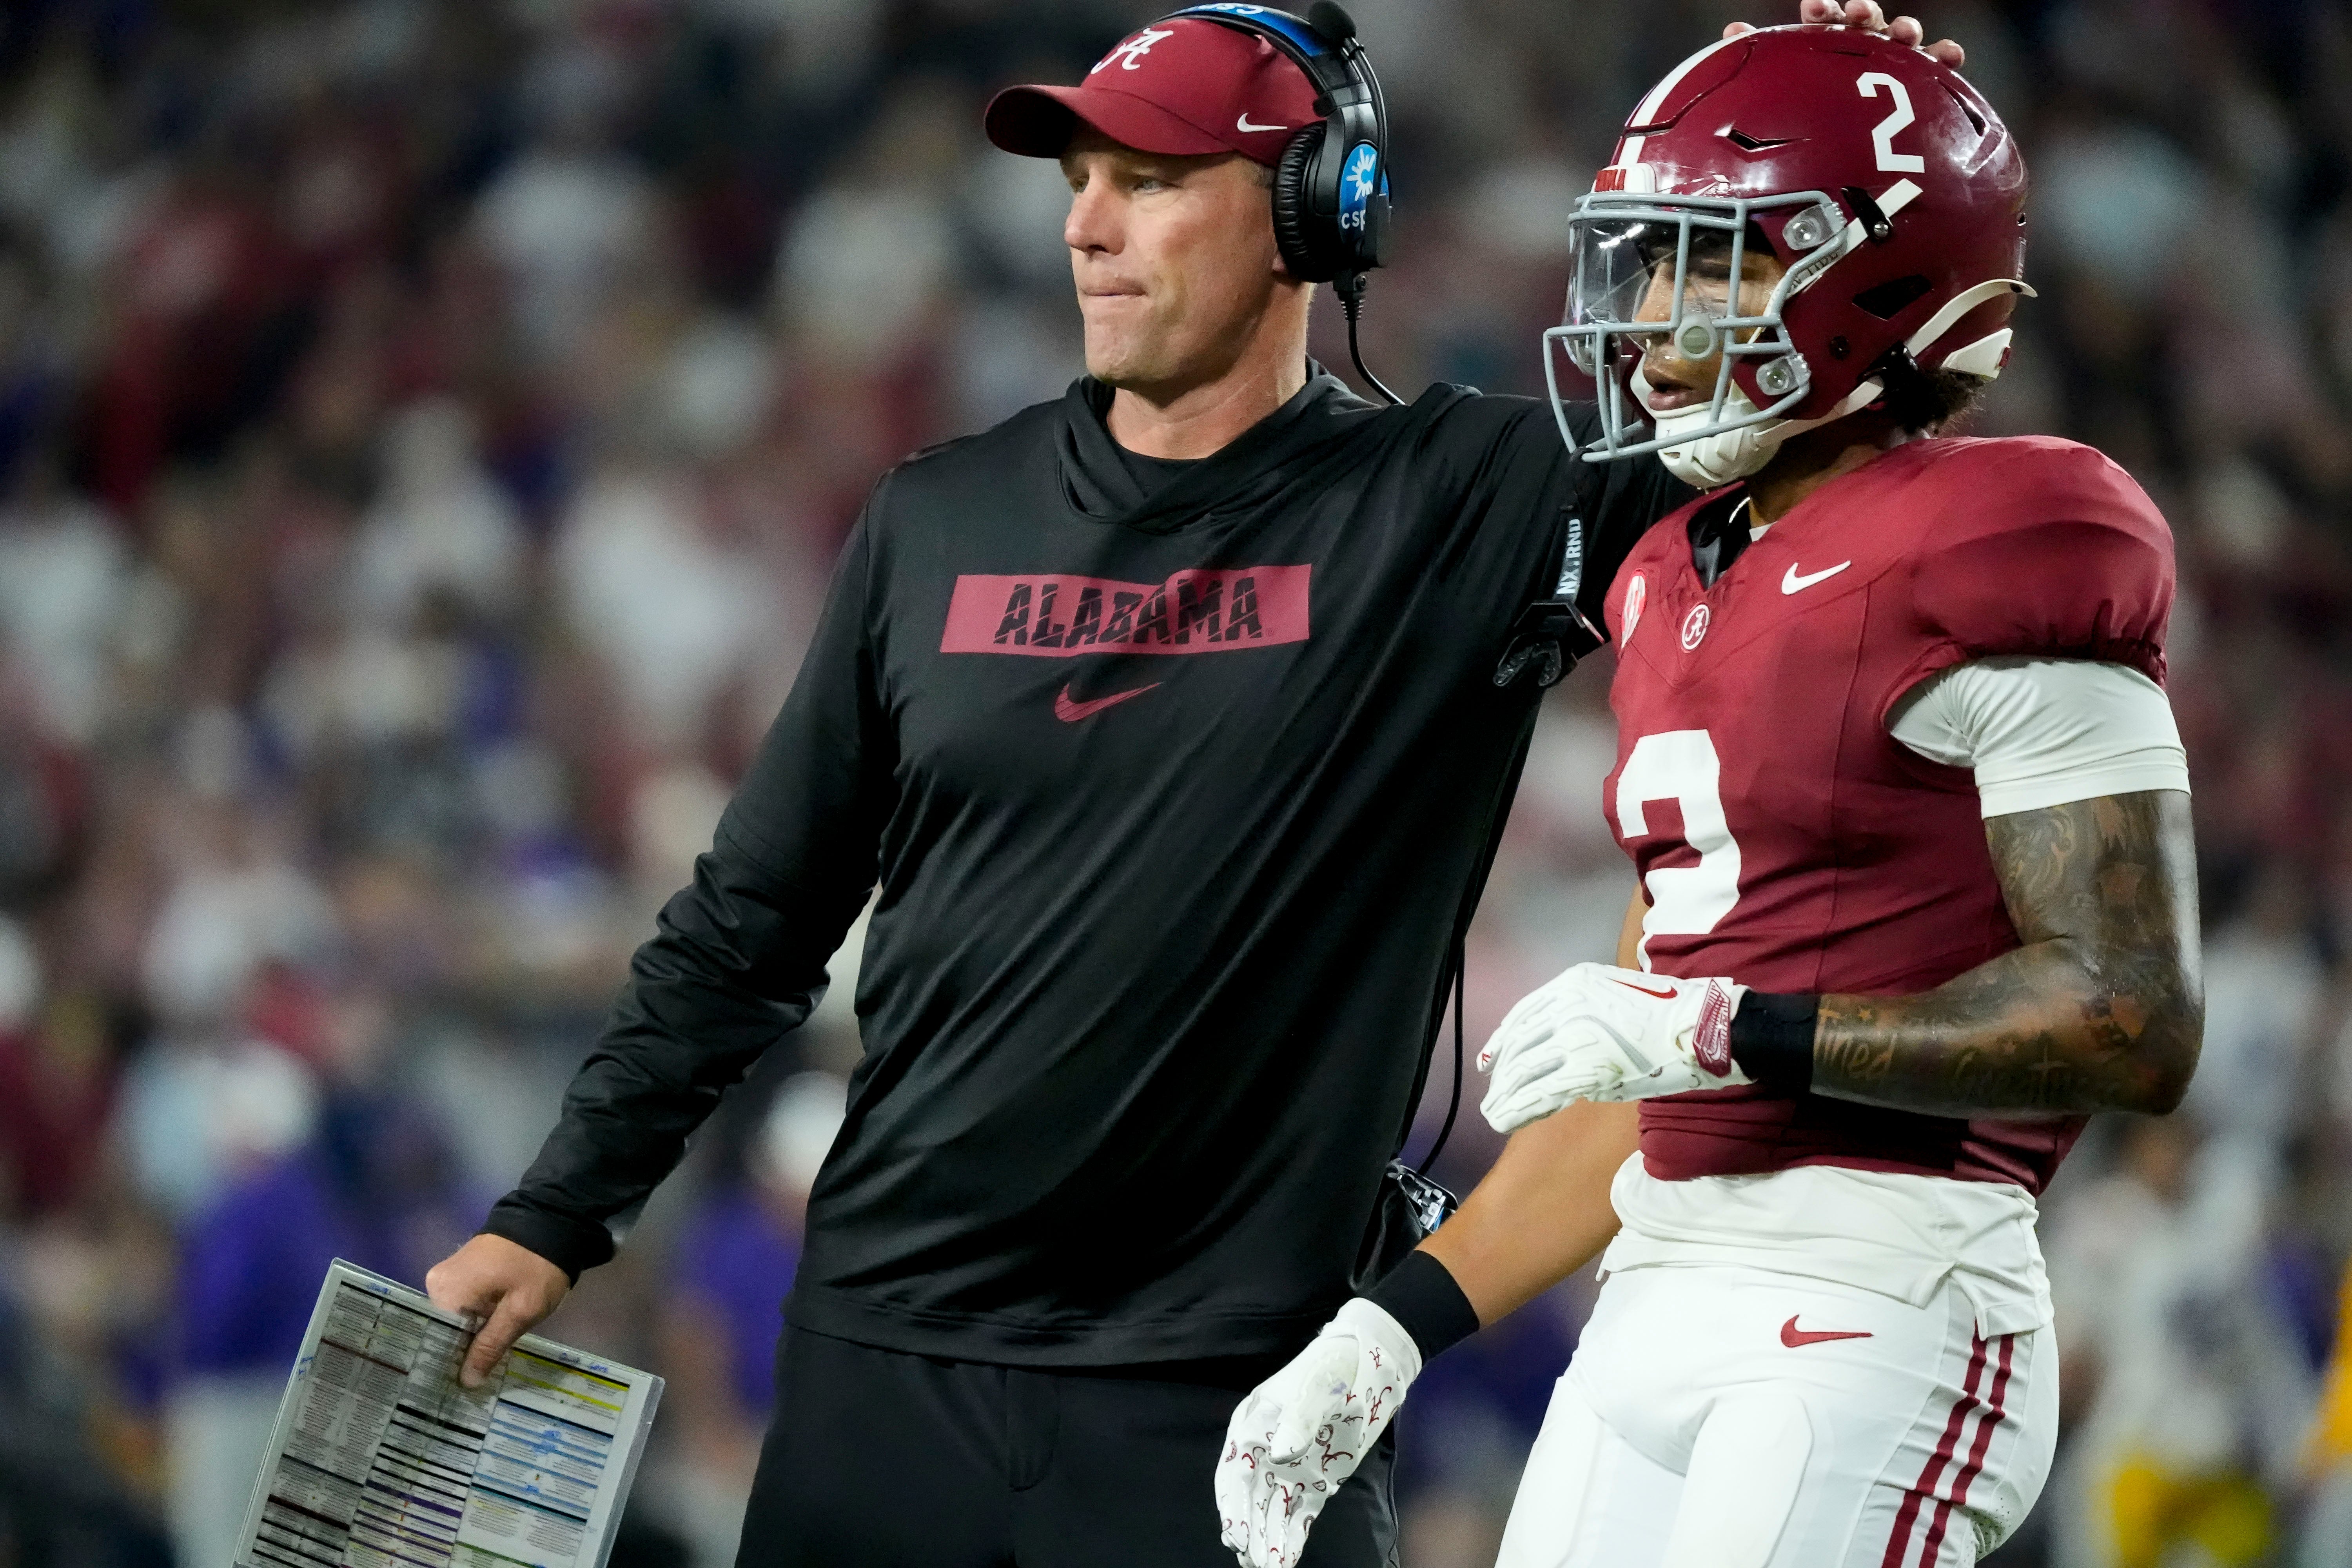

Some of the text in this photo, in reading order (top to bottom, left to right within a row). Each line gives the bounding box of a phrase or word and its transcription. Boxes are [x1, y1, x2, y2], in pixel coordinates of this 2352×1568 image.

[1856, 72, 1925, 173] 2
[993, 577, 1263, 649] ALABAMA
[1616, 729, 1741, 974] 2
